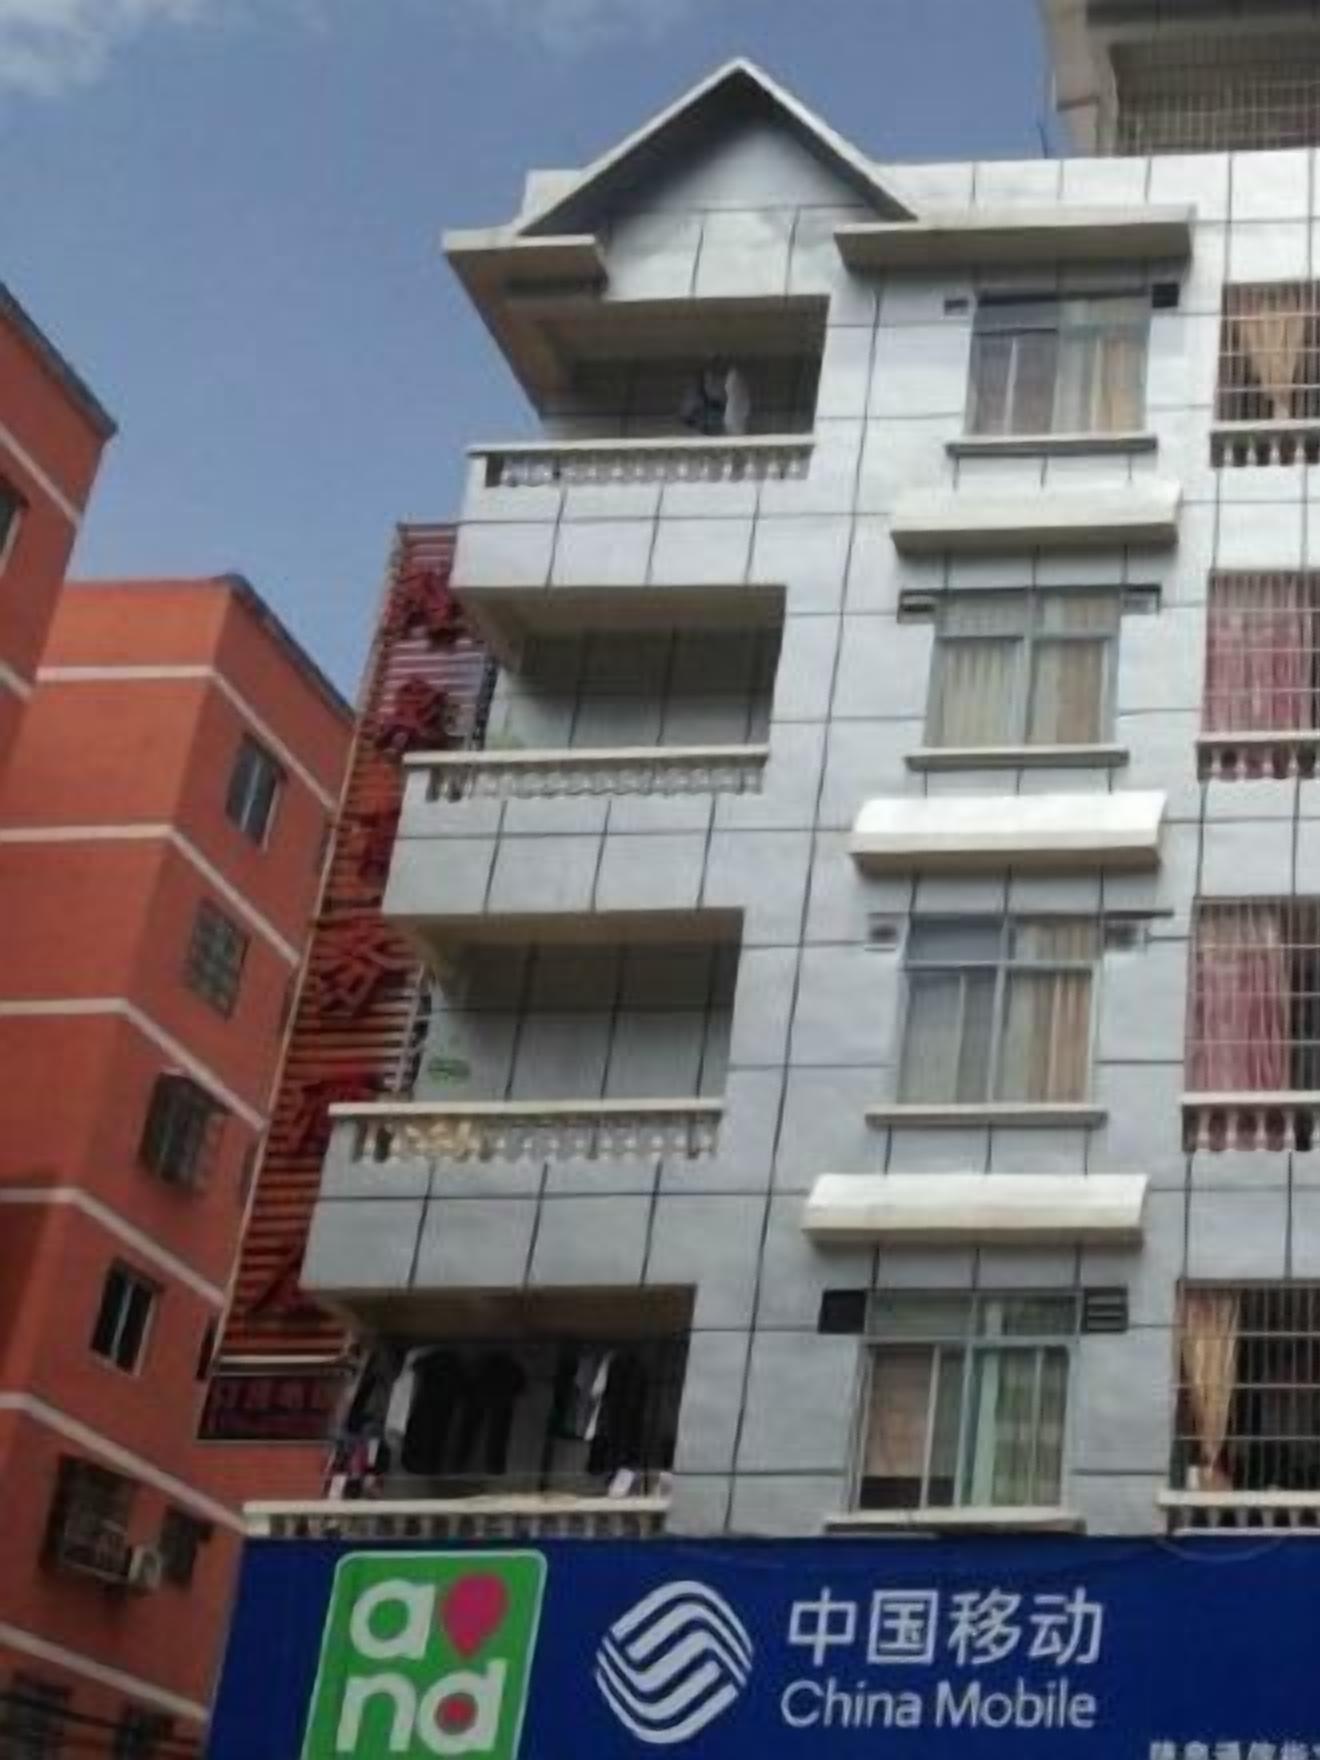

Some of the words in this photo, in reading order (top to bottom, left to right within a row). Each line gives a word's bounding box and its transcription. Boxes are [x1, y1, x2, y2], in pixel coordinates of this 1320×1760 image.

[788, 1586, 1104, 1667] 中国移动
[780, 1677, 922, 1728] China
[935, 1676, 1097, 1728] Mobile
